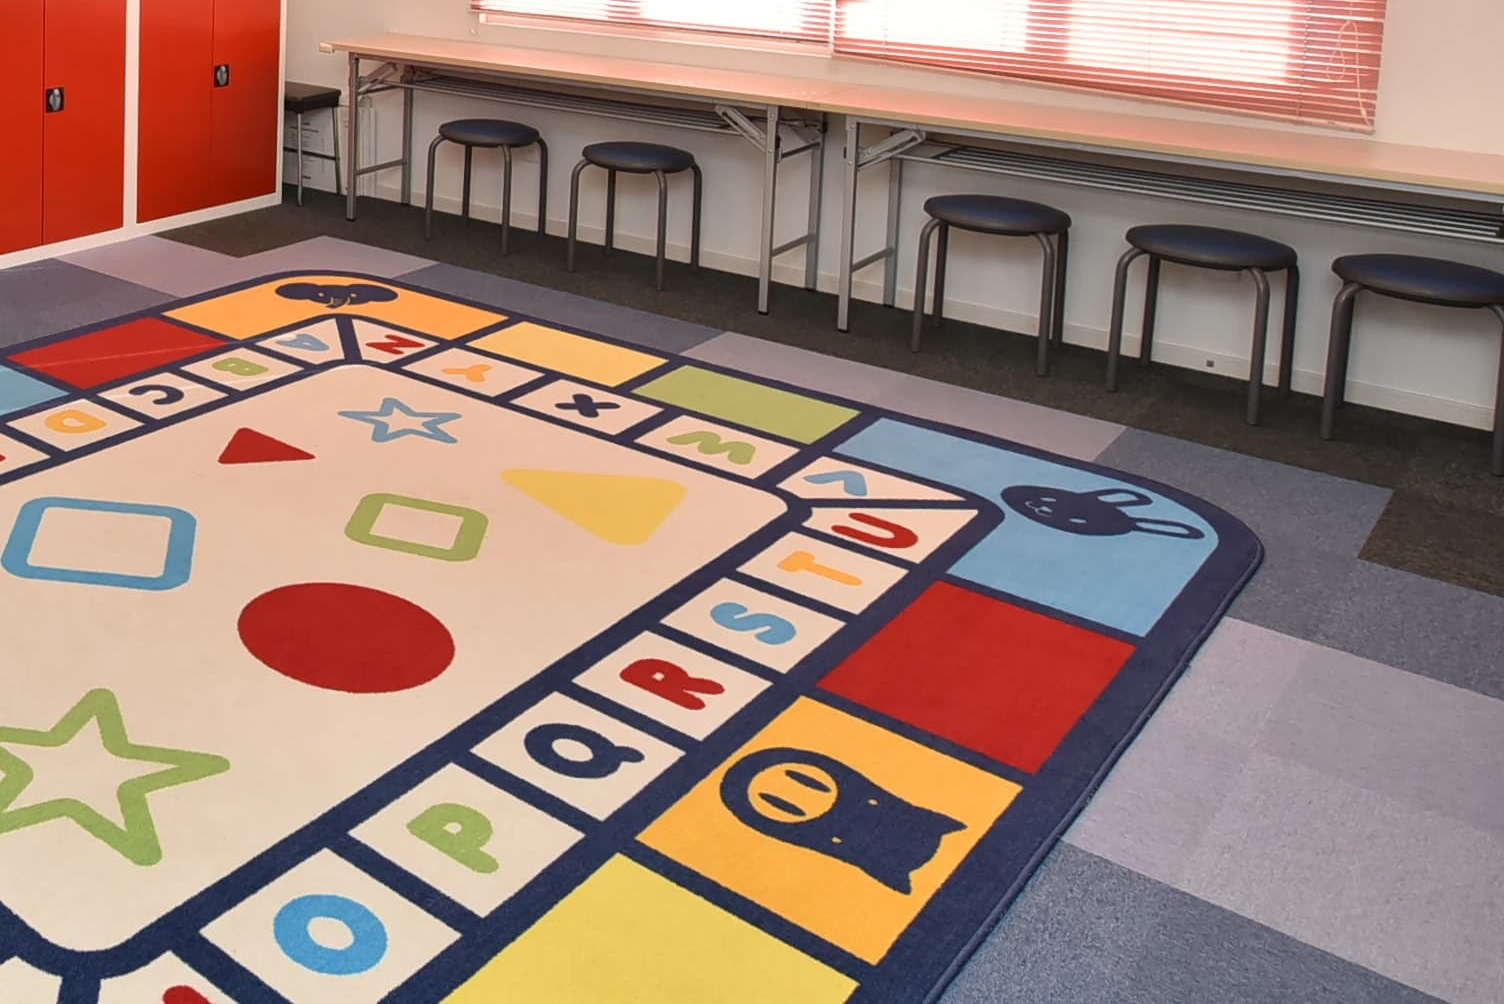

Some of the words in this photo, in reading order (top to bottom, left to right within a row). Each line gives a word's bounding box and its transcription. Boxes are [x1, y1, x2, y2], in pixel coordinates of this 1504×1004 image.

[275, 334, 329, 351] A
[212, 357, 269, 376] B
[443, 364, 491, 382] Y
[128, 384, 184, 405] C
[554, 393, 621, 418] X
[46, 410, 106, 433] D
[803, 470, 867, 497] V
[831, 512, 919, 549] U
[778, 551, 862, 586] T
[710, 602, 796, 645] S
[619, 658, 725, 711] R
[523, 723, 645, 779] Q
[406, 803, 499, 874] P
[273, 894, 388, 976] O
